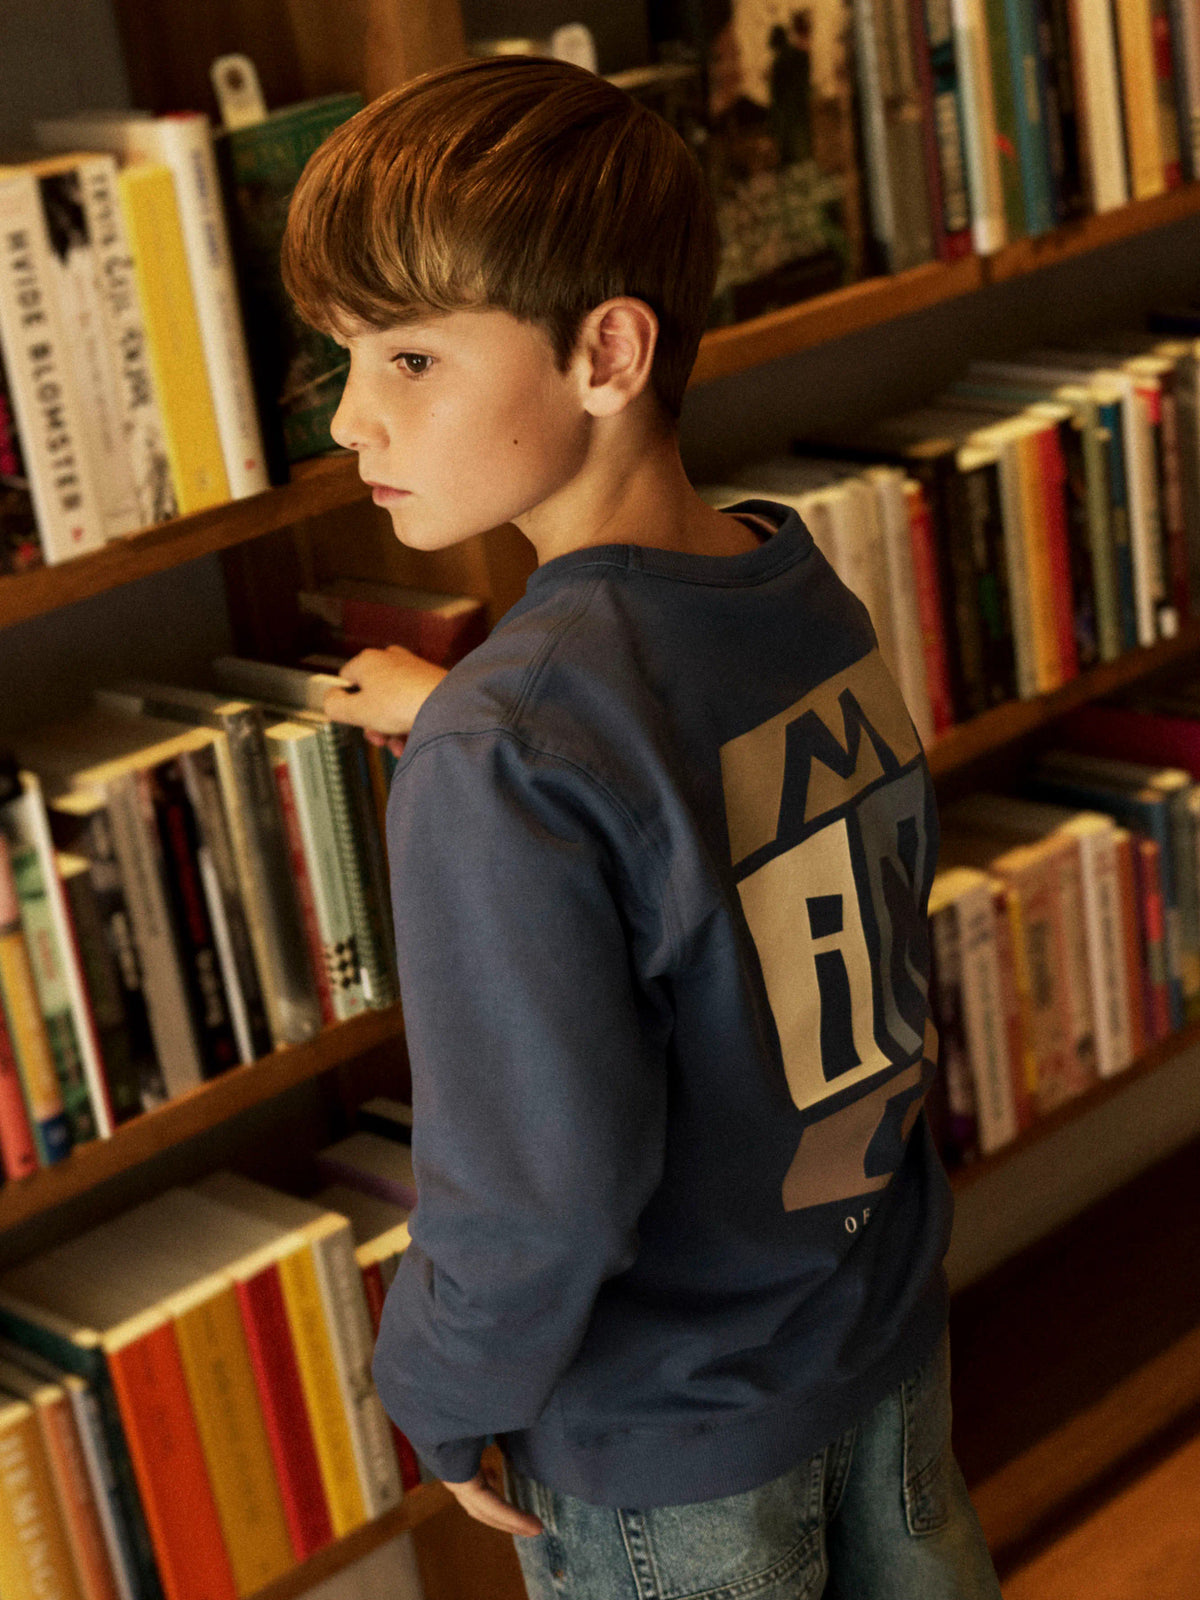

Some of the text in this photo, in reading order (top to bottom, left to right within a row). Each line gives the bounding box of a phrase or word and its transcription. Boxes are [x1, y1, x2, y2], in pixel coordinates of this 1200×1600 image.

[6, 229, 82, 512] HVIDE BLOMSTER
[844, 1207, 871, 1234] OF
